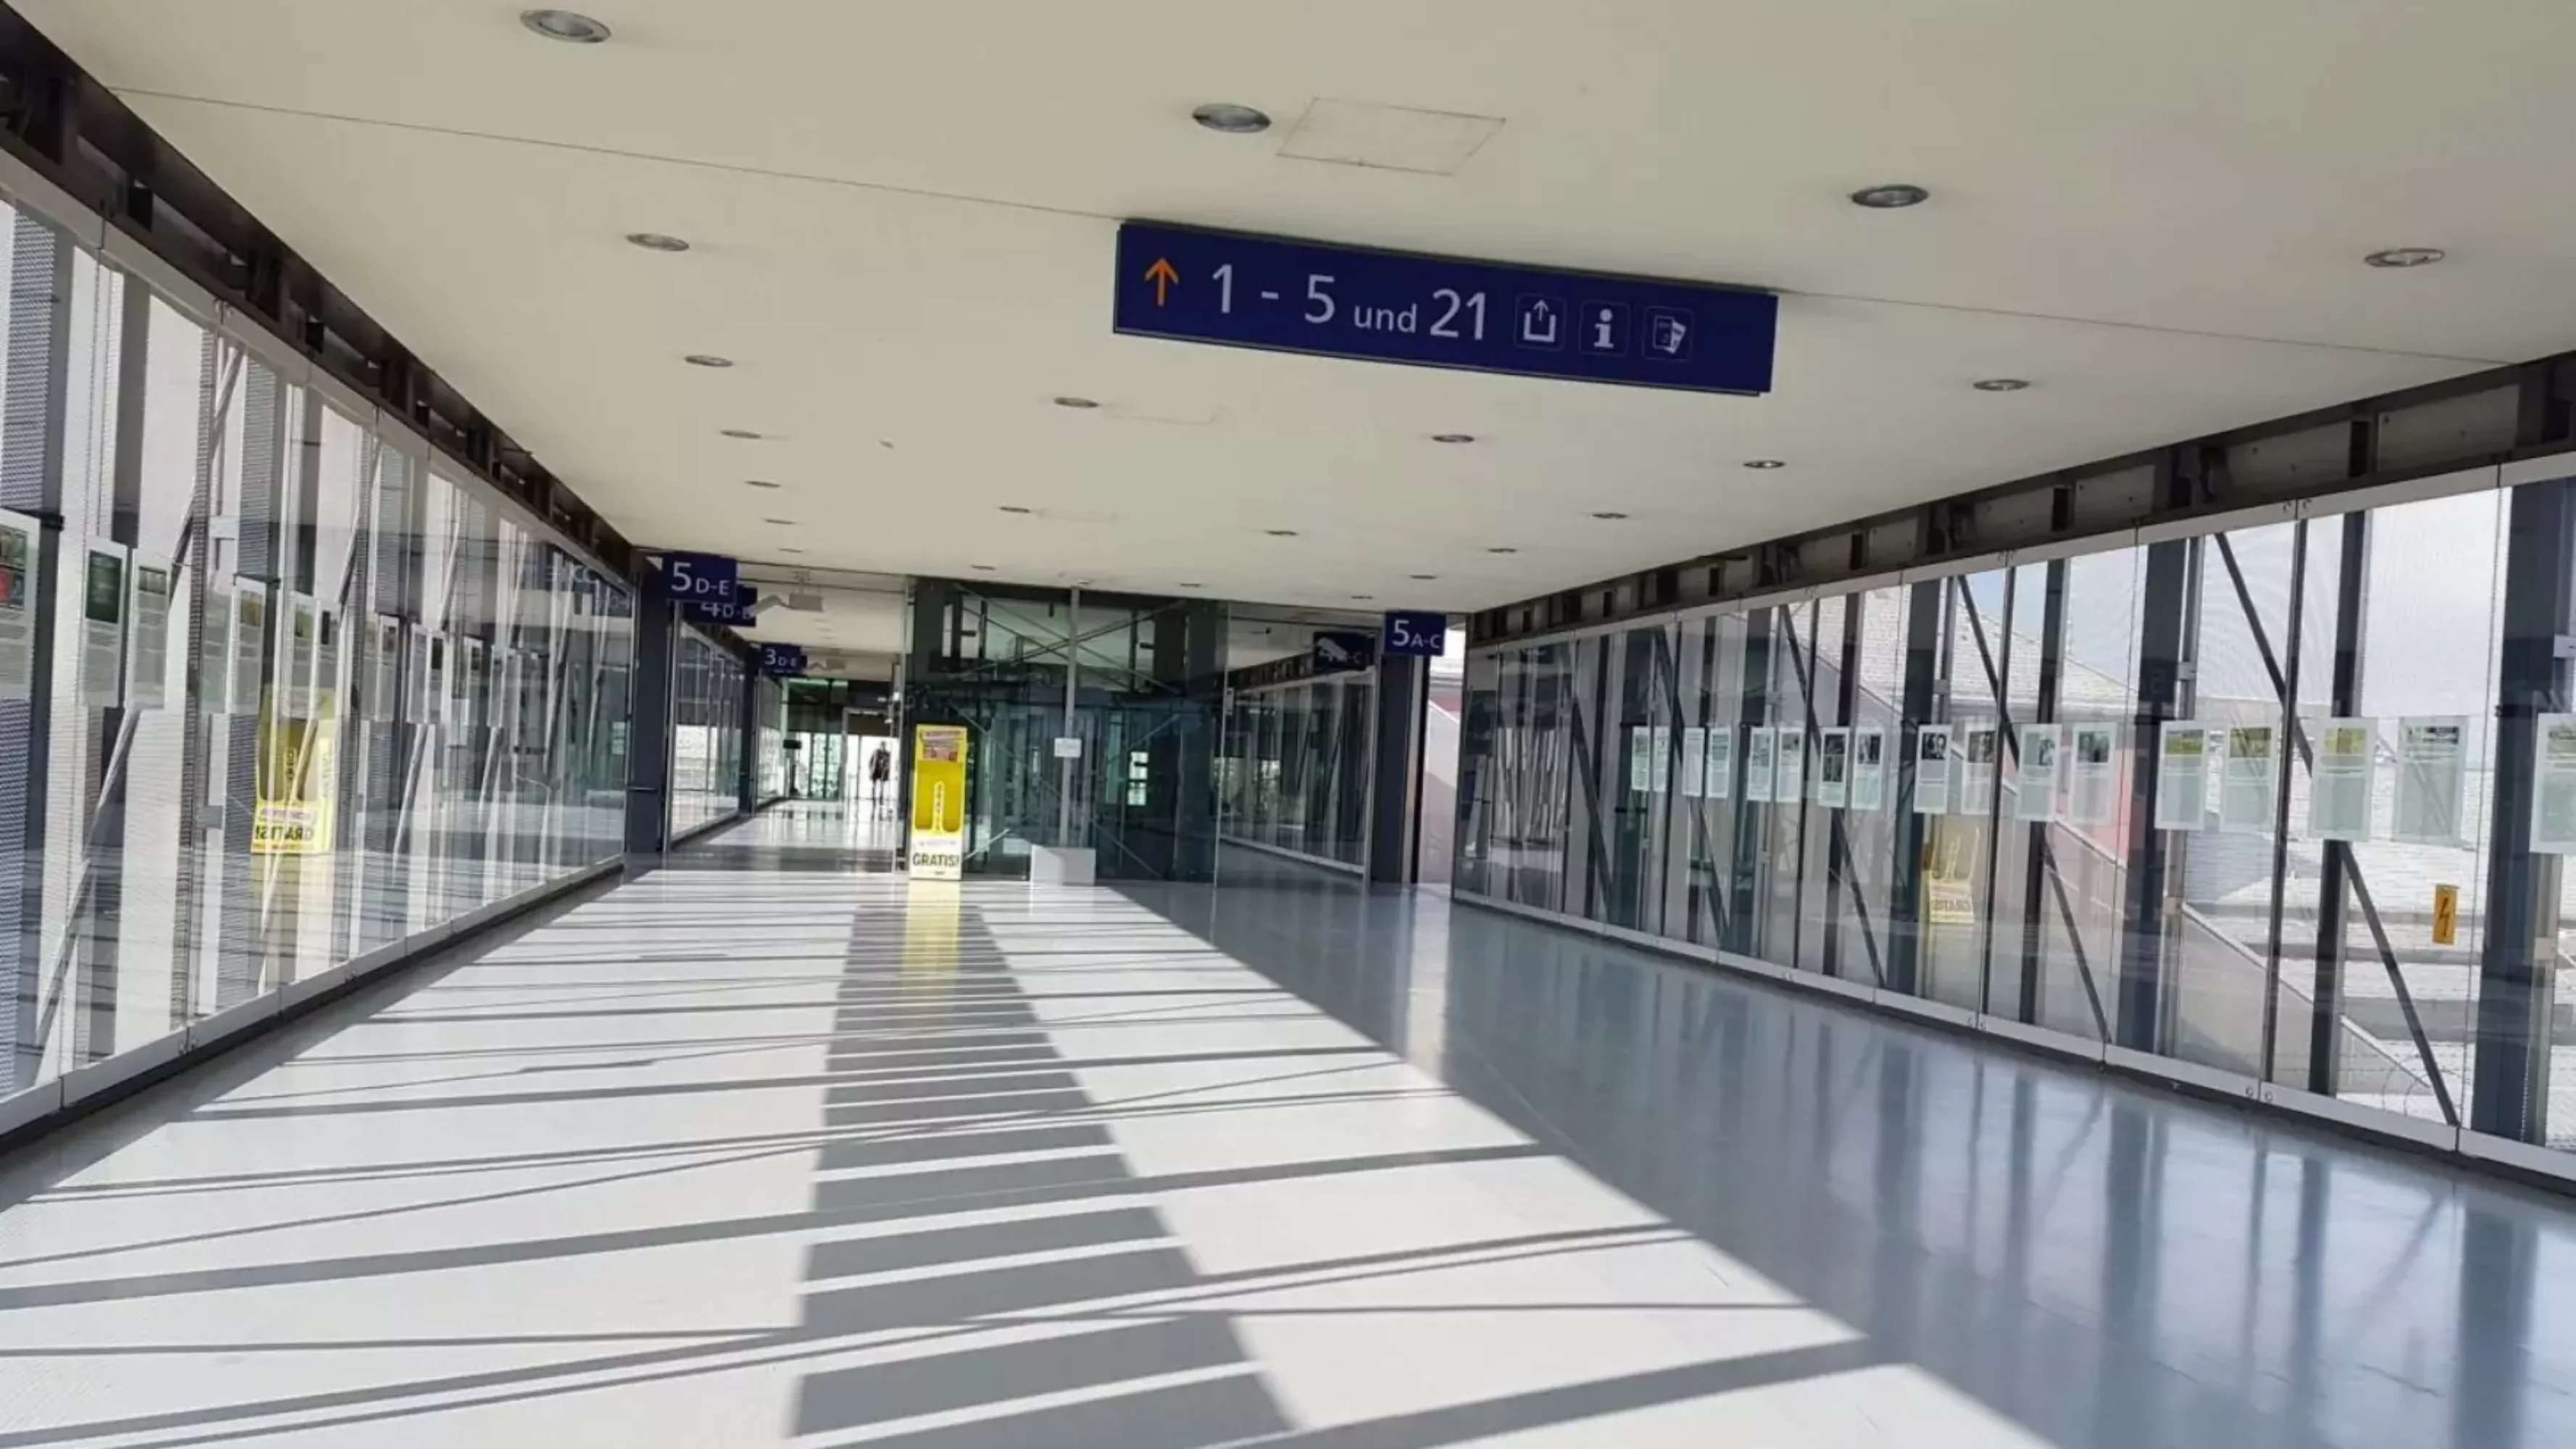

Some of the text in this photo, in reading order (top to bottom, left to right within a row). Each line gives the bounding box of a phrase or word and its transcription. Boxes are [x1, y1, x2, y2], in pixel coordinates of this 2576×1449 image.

[1212, 264, 1232, 313] 1
[1305, 275, 1335, 323] 5
[1354, 303, 1417, 333] und
[1430, 288, 1485, 340] 21
[913, 852, 960, 868] GRATIS!
